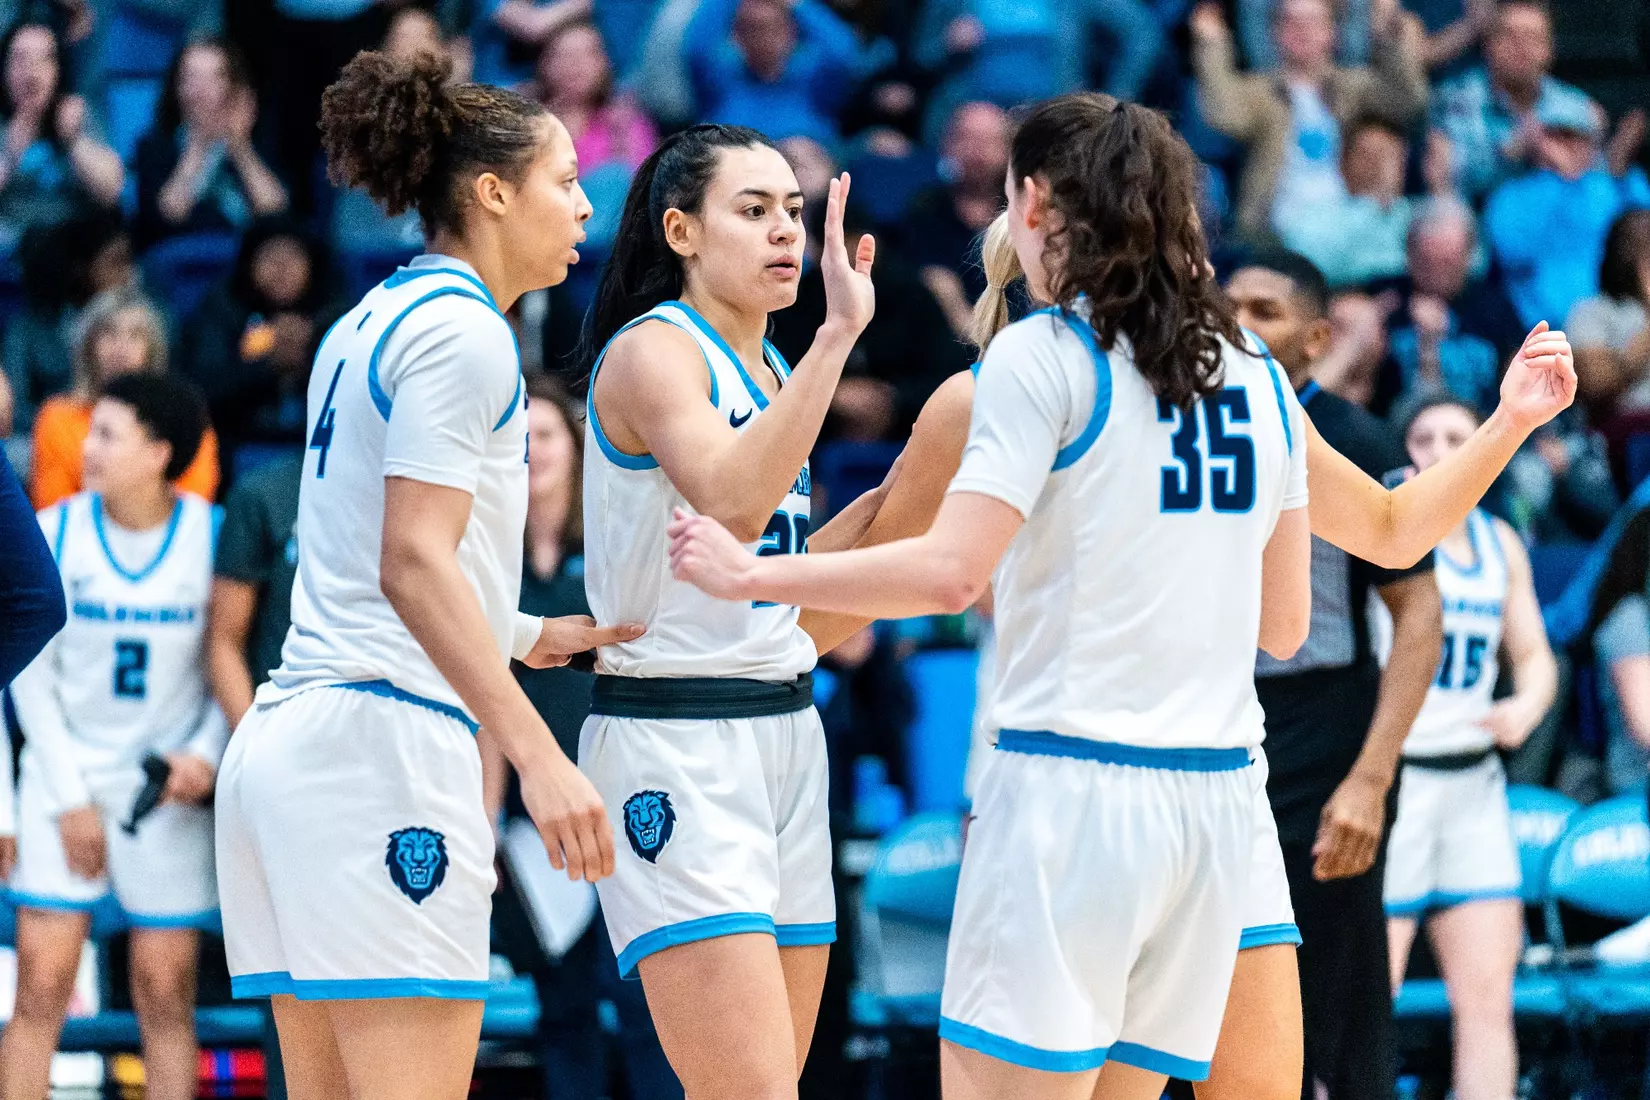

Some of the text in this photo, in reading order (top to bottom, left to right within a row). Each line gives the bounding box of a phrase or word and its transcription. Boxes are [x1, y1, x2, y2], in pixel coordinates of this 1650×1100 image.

[309, 359, 346, 479] 4
[1155, 385, 1257, 514] 35
[114, 640, 149, 698] 2
